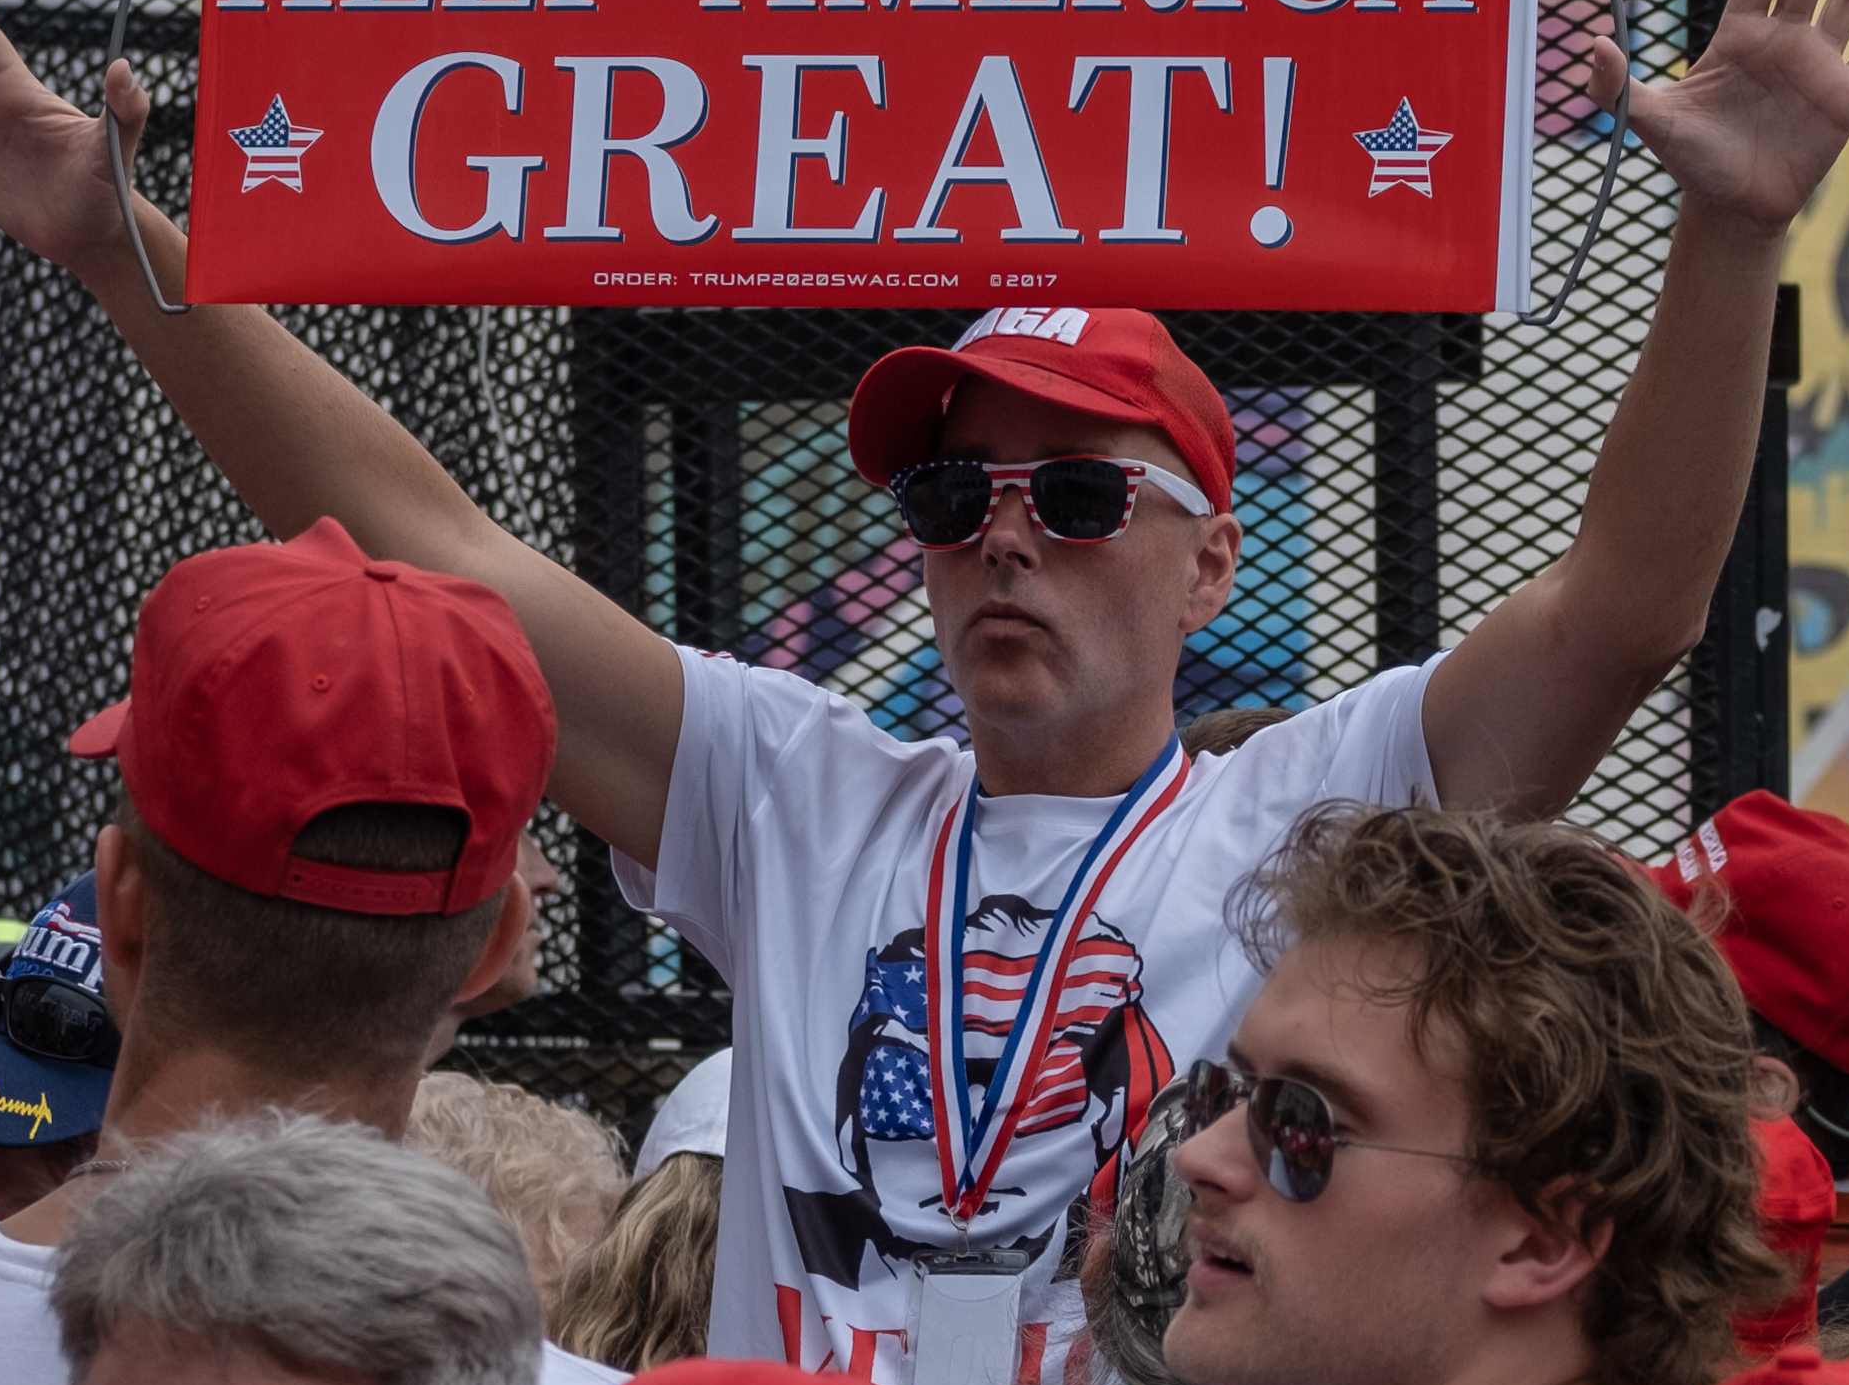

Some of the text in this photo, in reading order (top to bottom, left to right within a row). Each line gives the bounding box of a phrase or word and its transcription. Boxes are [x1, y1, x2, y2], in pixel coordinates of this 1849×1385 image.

[369, 50, 1299, 249] GREAT!
[593, 271, 679, 287] ORDER:
[690, 272, 960, 288] TRUMP2020SWAG.COM
